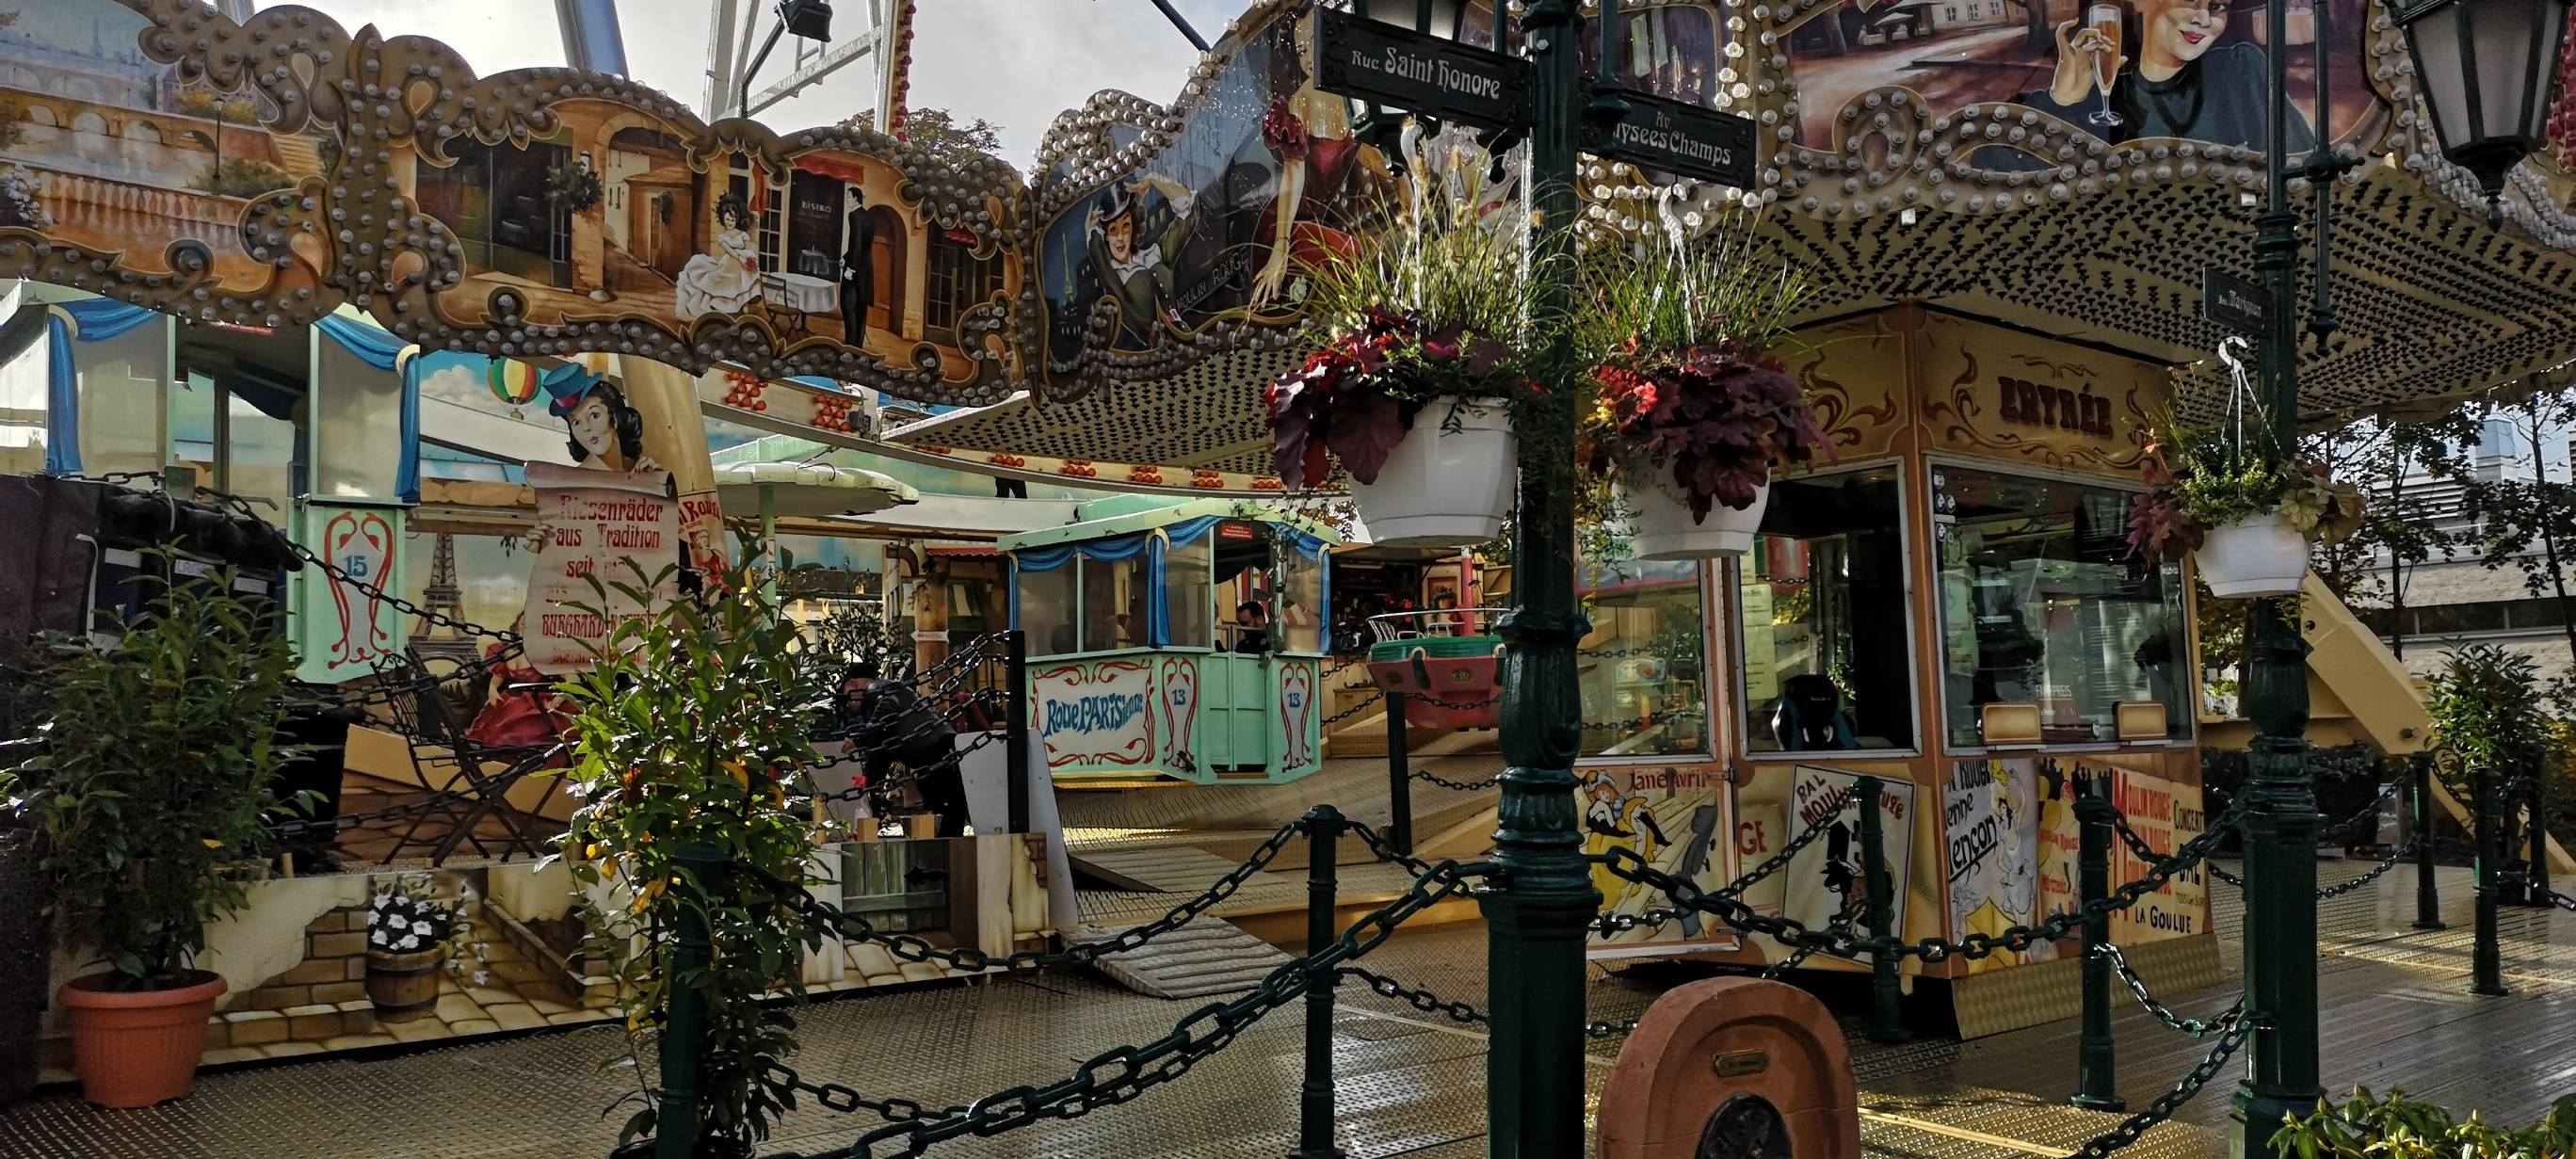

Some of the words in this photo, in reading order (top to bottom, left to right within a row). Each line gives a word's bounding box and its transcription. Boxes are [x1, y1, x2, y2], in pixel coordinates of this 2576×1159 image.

[1385, 46, 1434, 83] Saint
[1437, 59, 1501, 100] Honore
[1669, 130, 1731, 167] Champs
[1176, 280, 1207, 311] MOULIN
[1212, 245, 1249, 285] ROUGE
[555, 527, 582, 547] aus
[596, 523, 660, 548] Tradition
[345, 555, 368, 576] 15
[566, 555, 594, 578] seit
[1171, 688, 1186, 705] 13
[1288, 692, 1301, 708] 13
[1626, 769, 1666, 793] Jane
[1670, 768, 1706, 789] Avril
[1796, 774, 1827, 805] BAL
[2135, 906, 2146, 925] LA
[2149, 905, 2192, 934] GOULUE
